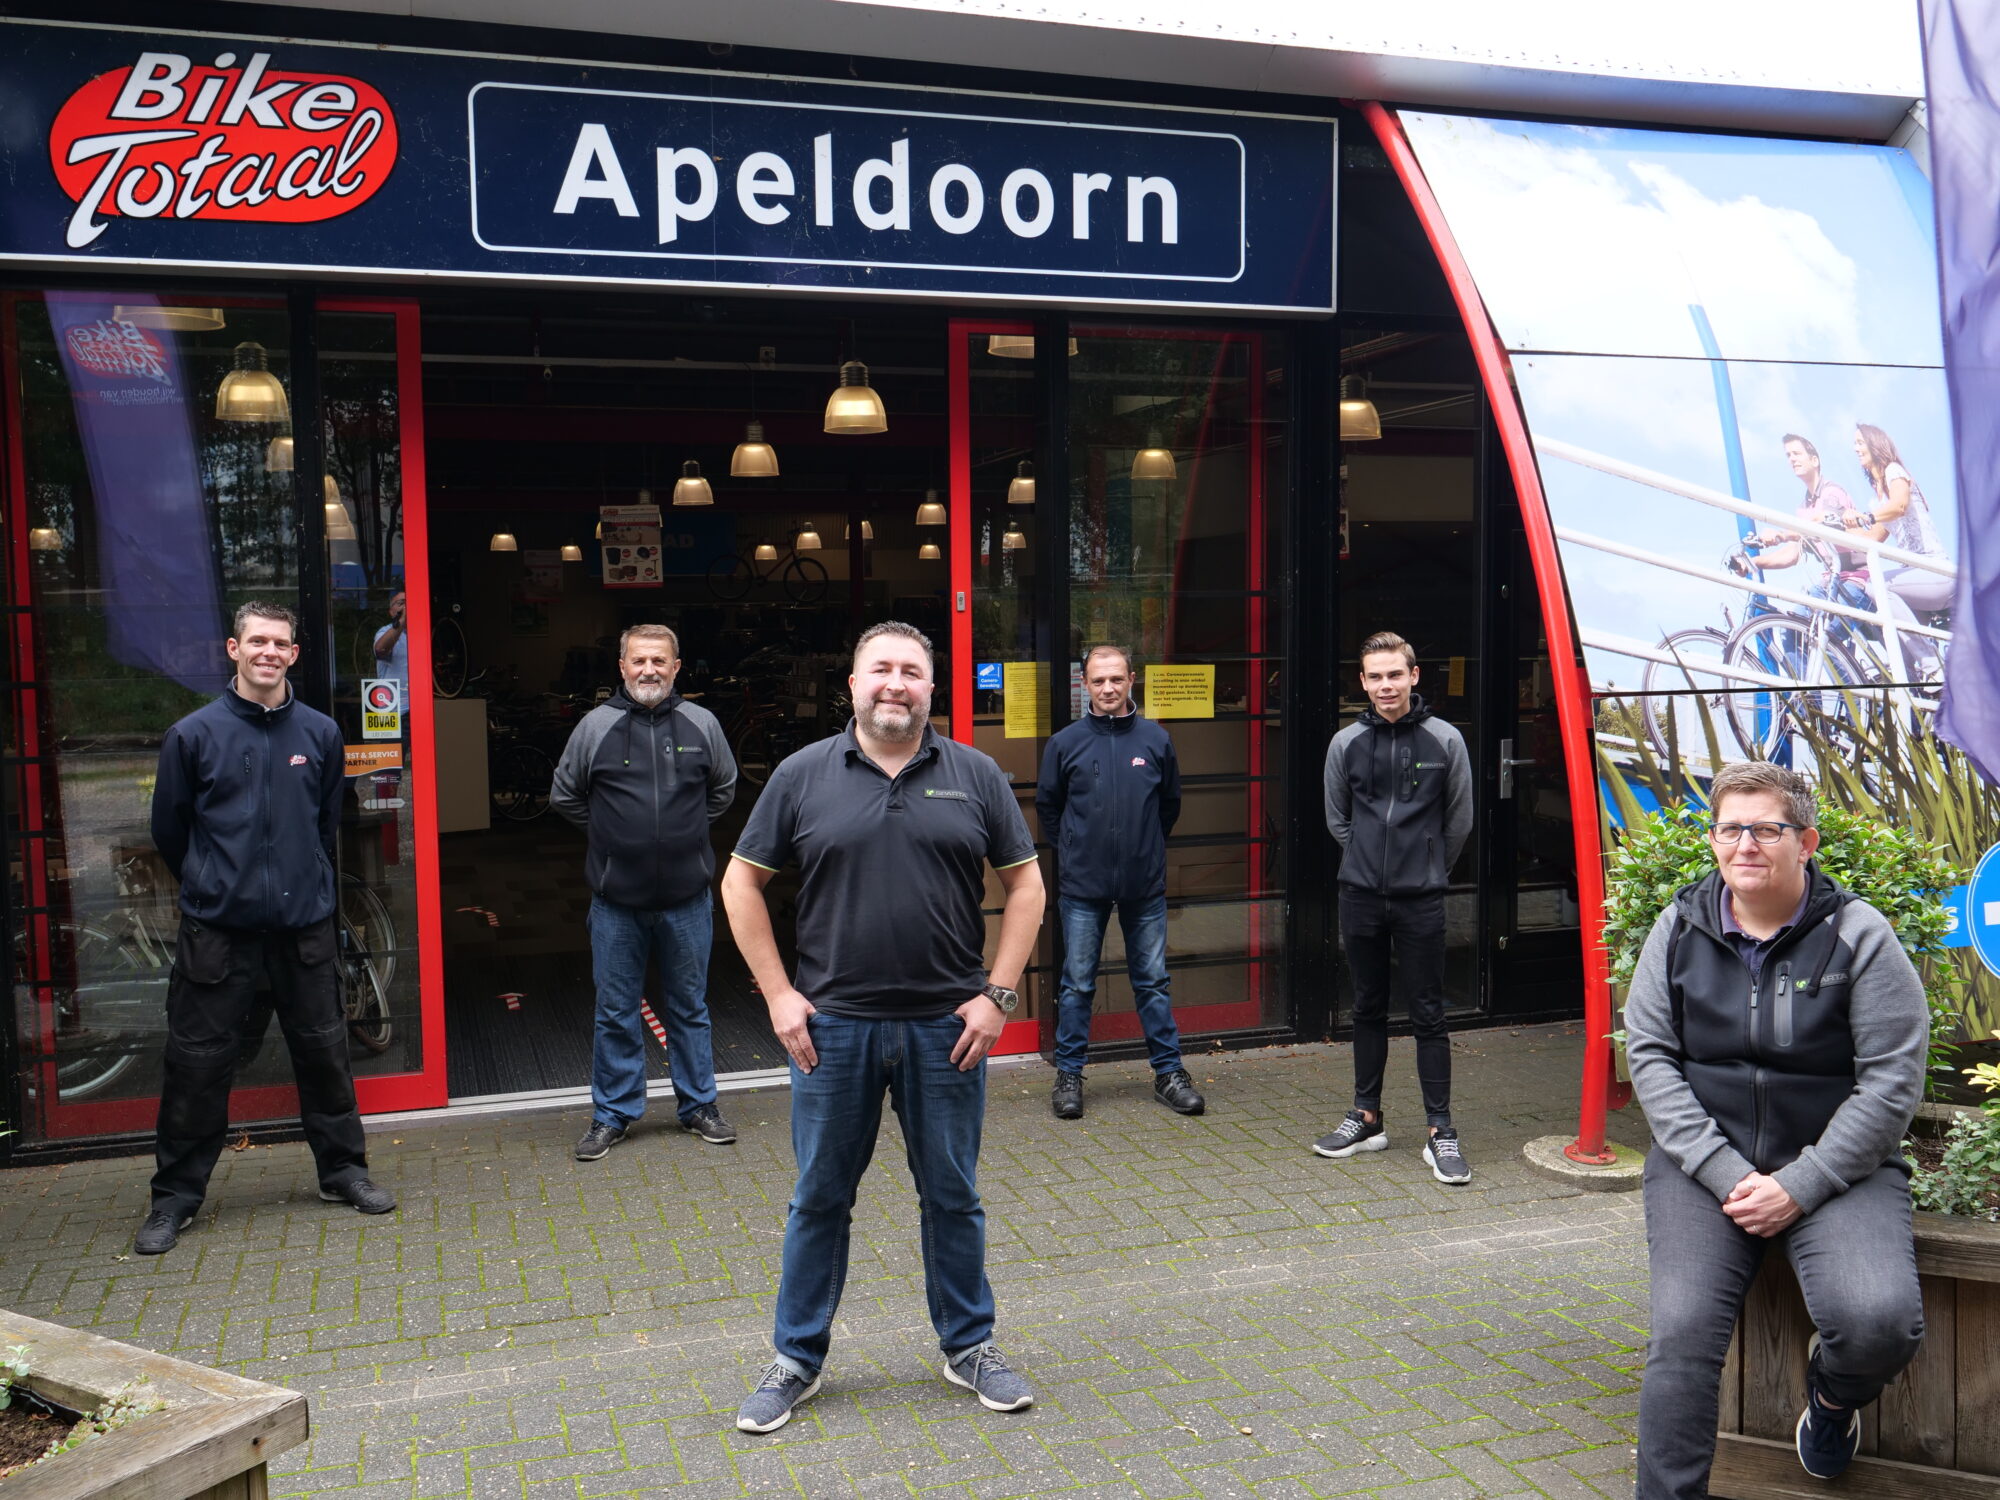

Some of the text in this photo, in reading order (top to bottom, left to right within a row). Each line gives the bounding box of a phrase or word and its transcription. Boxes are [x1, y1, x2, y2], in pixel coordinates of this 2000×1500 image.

[110, 51, 355, 131] Bike
[66, 107, 383, 249] Totaal
[553, 122, 1179, 246] Apeldoorn
[367, 715, 396, 728] BOVAG
[368, 750, 399, 759] SERVICE
